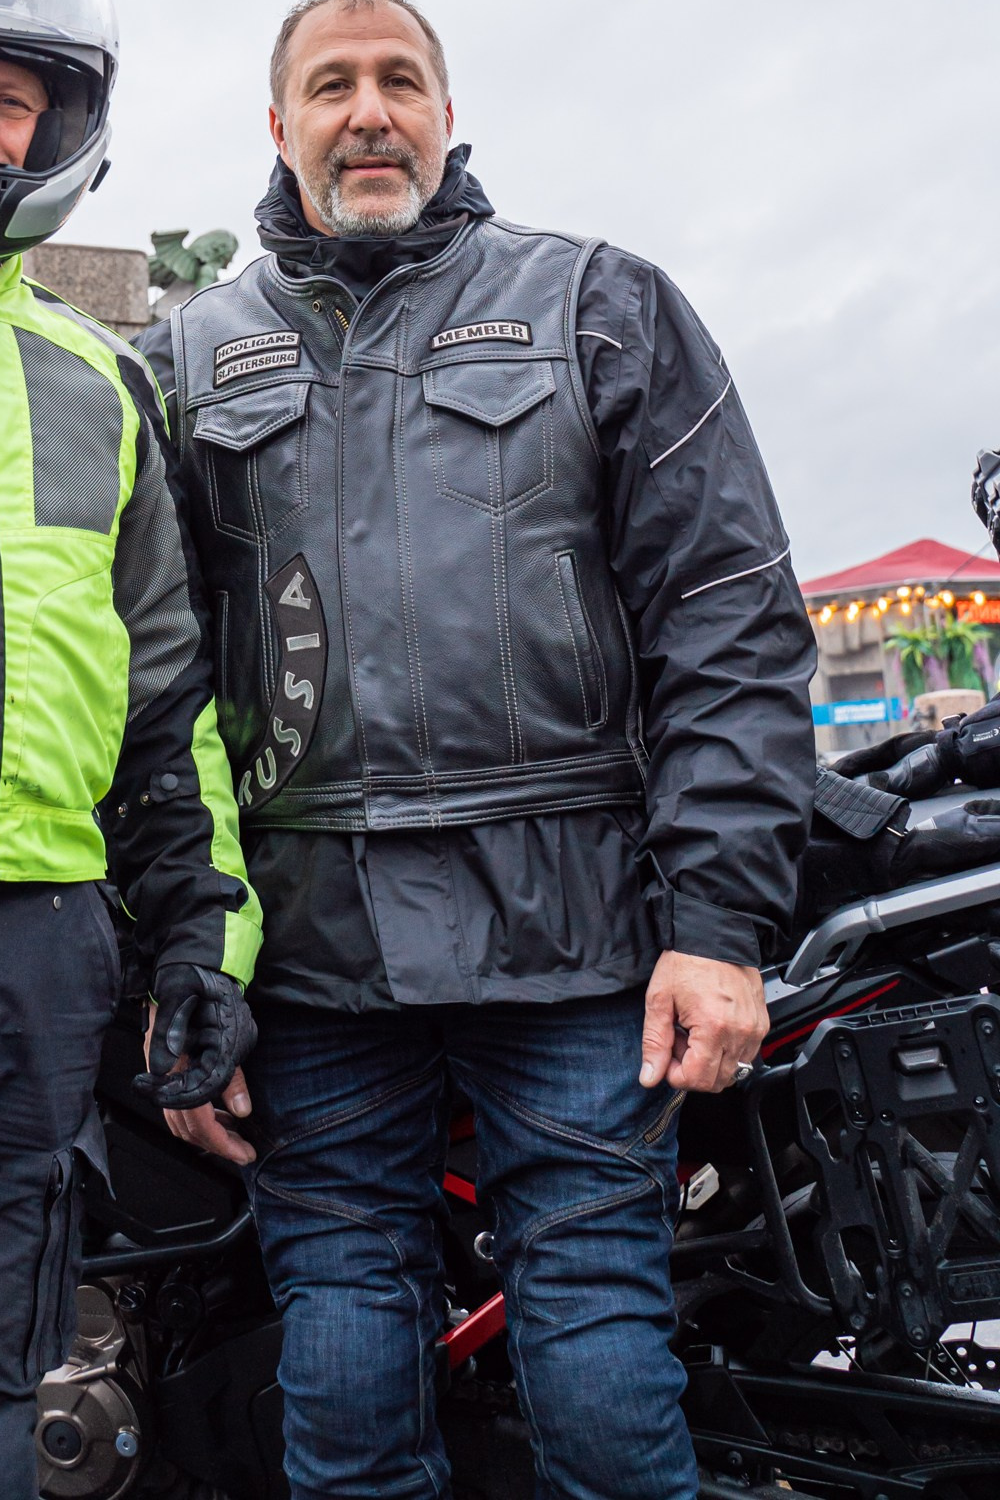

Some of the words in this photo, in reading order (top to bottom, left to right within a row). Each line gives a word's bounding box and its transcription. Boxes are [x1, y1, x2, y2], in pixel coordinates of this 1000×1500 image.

[217, 334, 296, 361] HOOLIGANS
[438, 323, 524, 345] MEMBER
[237, 571, 321, 806] RUSSIA
